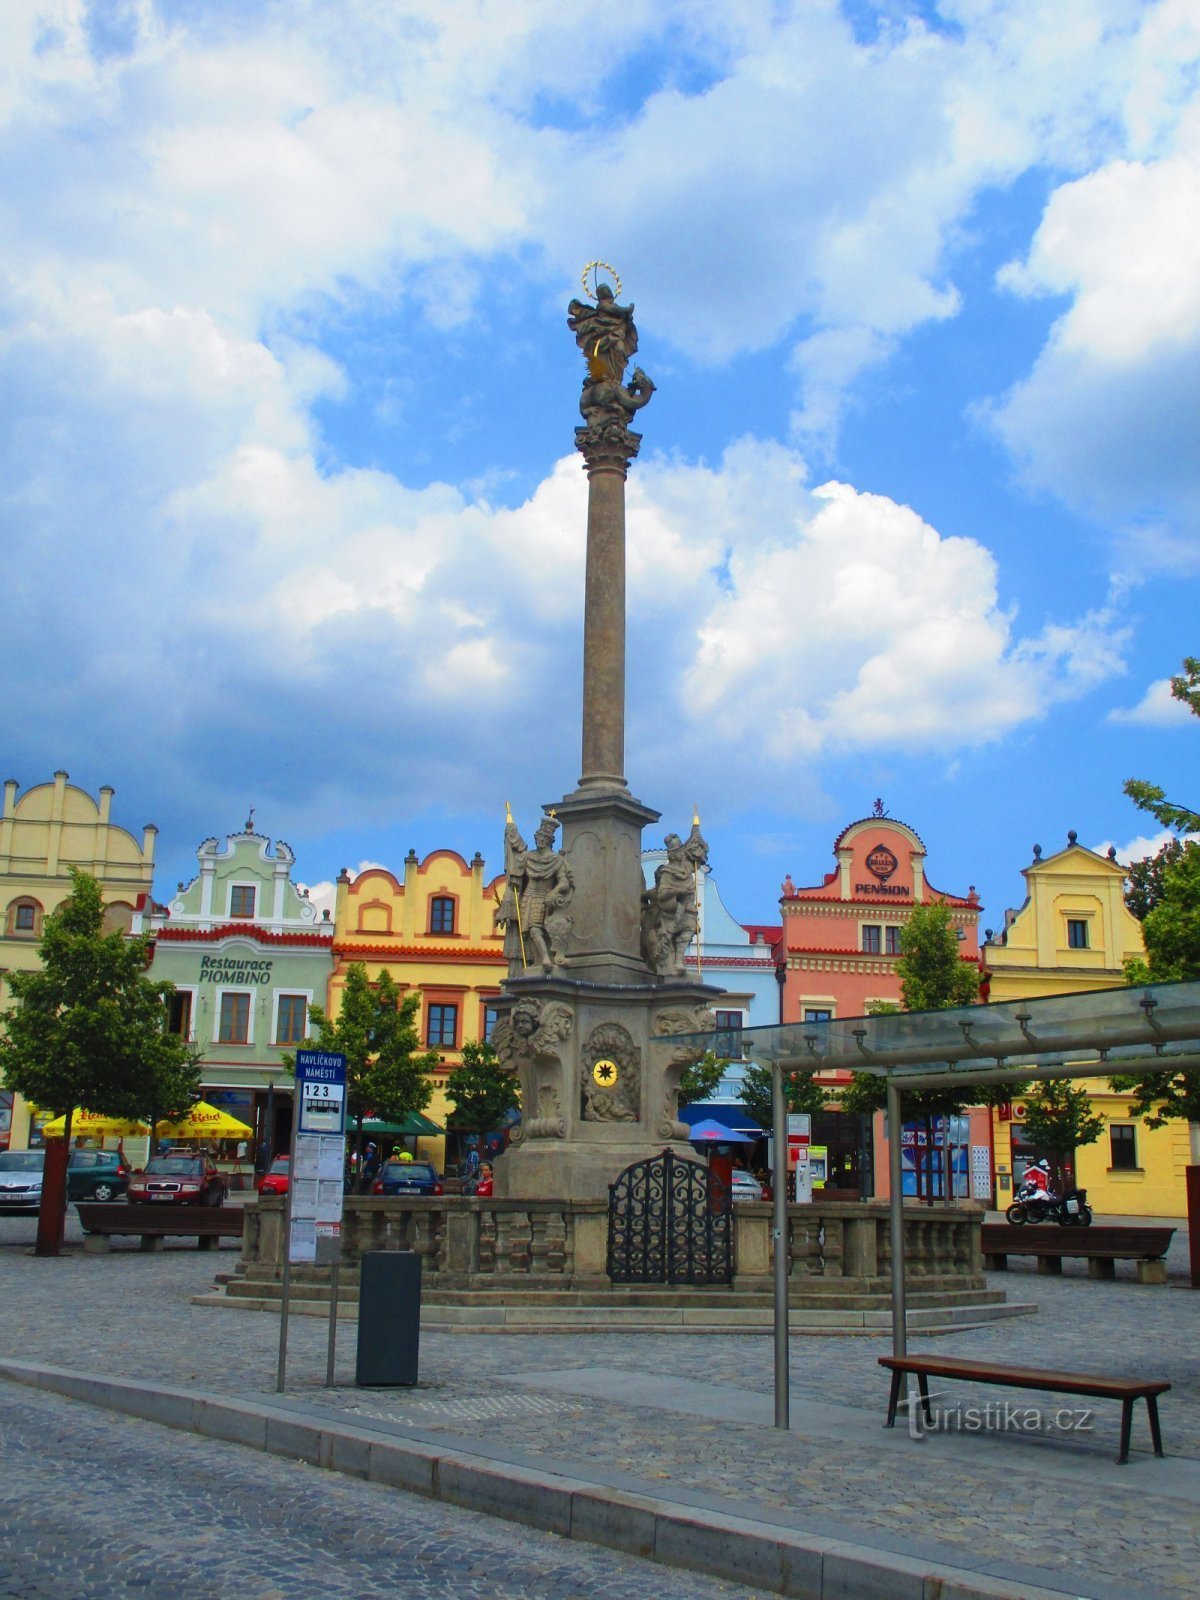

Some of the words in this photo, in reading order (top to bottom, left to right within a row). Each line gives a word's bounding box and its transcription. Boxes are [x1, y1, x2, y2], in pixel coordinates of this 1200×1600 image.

[856, 884, 910, 896] PENSION
[201, 955, 273, 970] Restaurace
[199, 969, 271, 984] PIOMBINO
[300, 1054, 342, 1068] HAVLÍČKOVO
[305, 1067, 336, 1079] NÁMĚSTÍ
